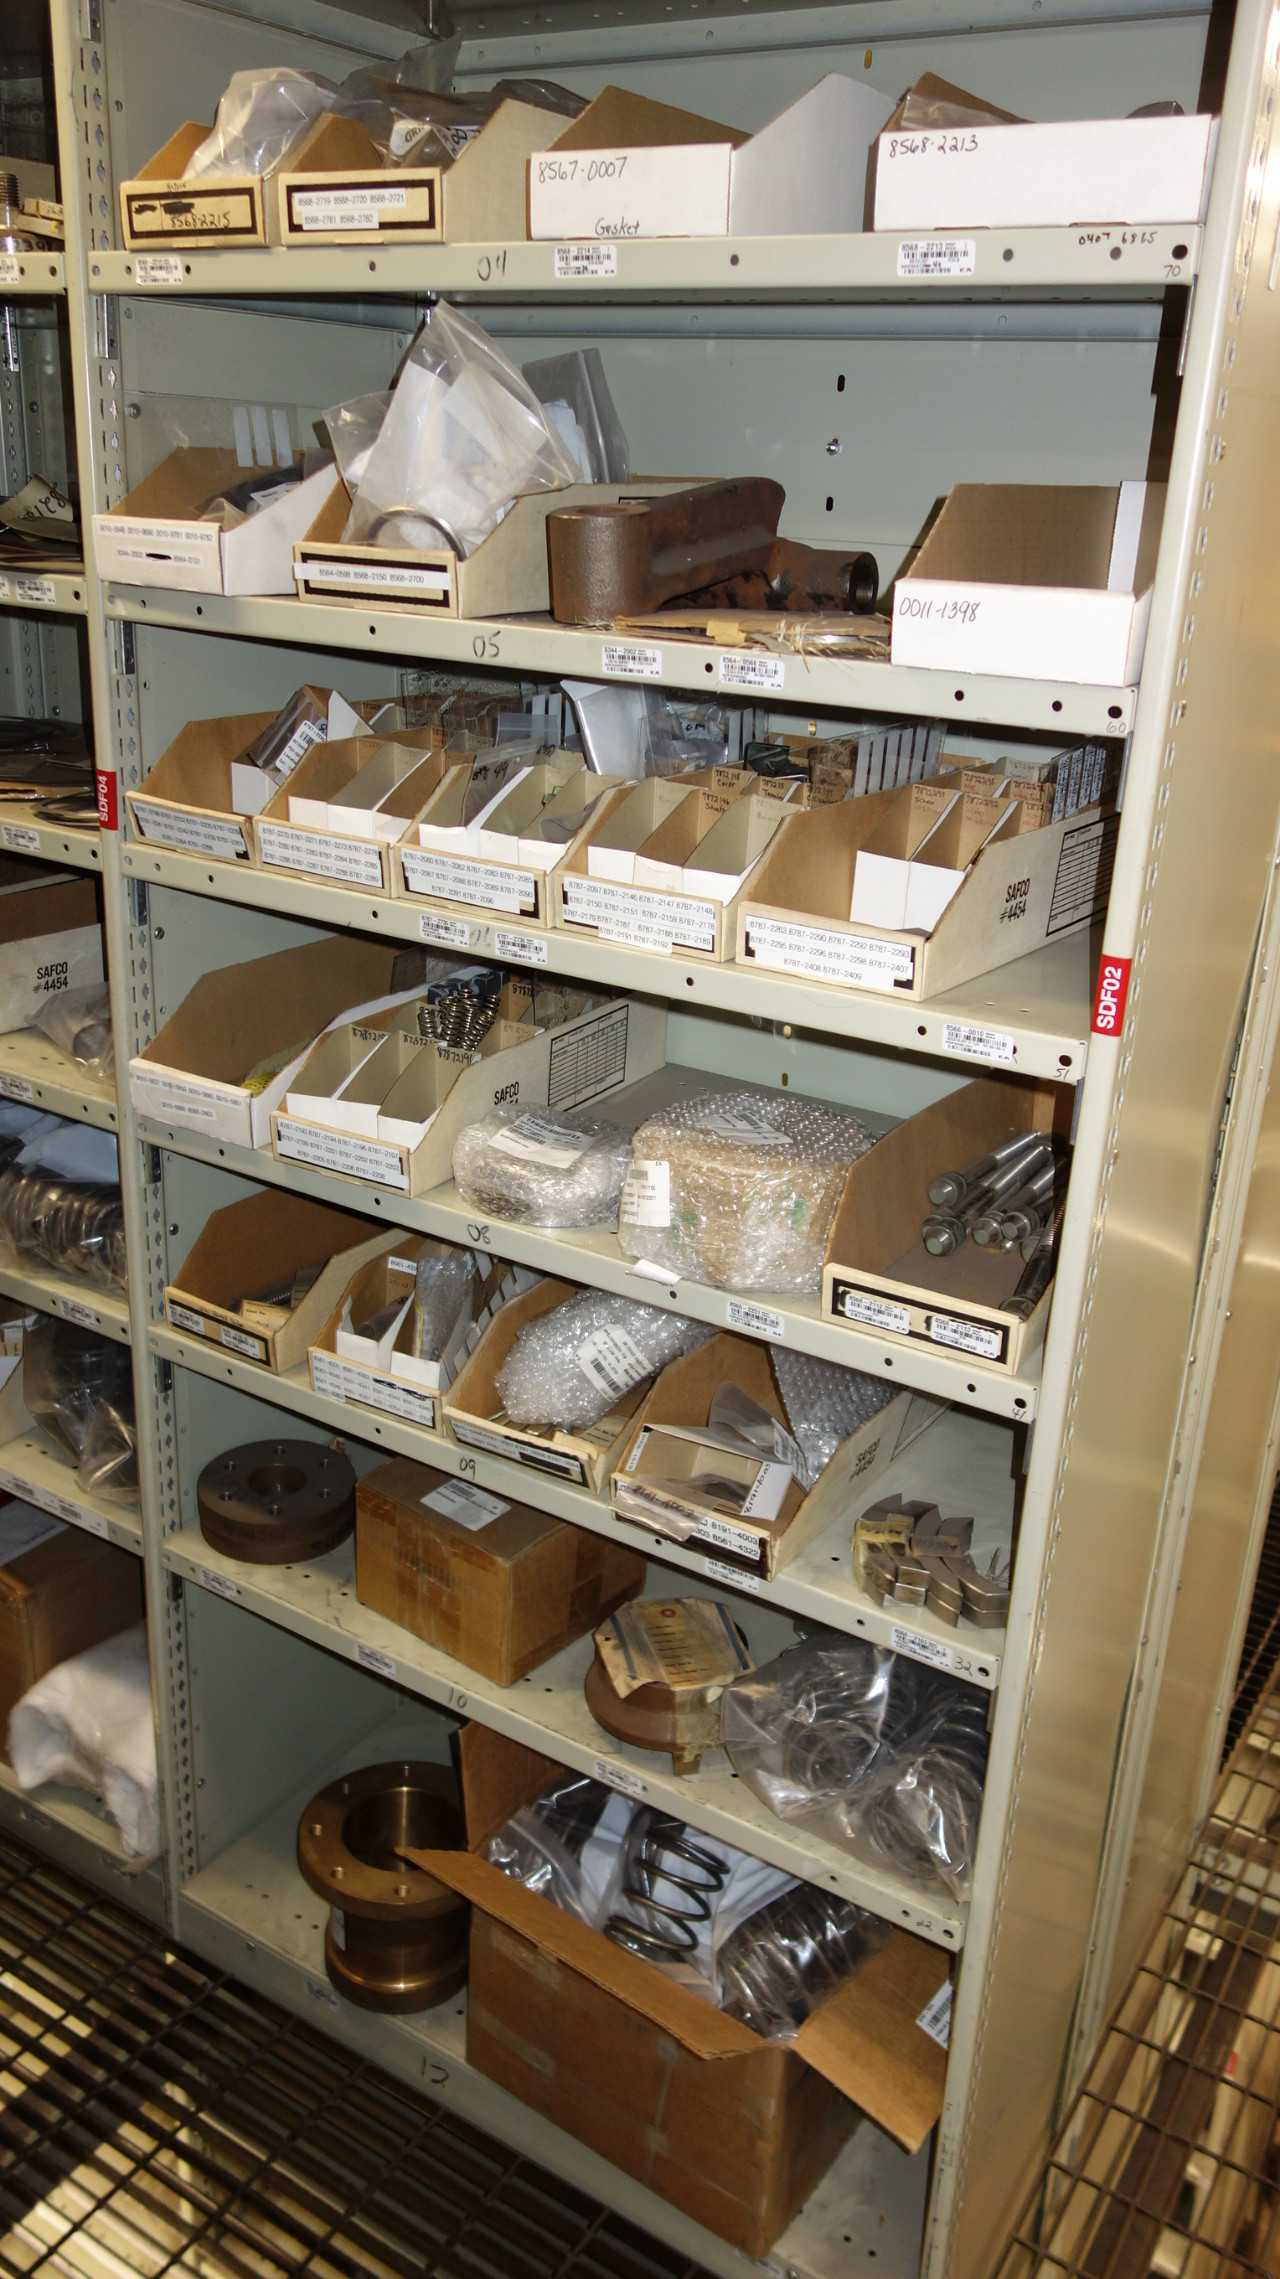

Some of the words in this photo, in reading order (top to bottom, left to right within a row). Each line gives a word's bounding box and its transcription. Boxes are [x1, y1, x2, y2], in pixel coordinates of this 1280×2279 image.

[1163, 265, 1181, 278] 70
[899, 596, 981, 624] 0011-1398
[472, 630, 501, 658] 05
[98, 775, 109, 823] SDF04
[1005, 878, 1030, 904] SAFCO
[36, 961, 69, 980] SAFCO
[1096, 966, 1122, 1030] SDF02
[1054, 1067, 1070, 1080] 51
[494, 1081, 520, 1105] SAFCO
[467, 1223, 491, 1244] 08
[459, 1456, 477, 1481] 09
[448, 1686, 468, 1709] 10
